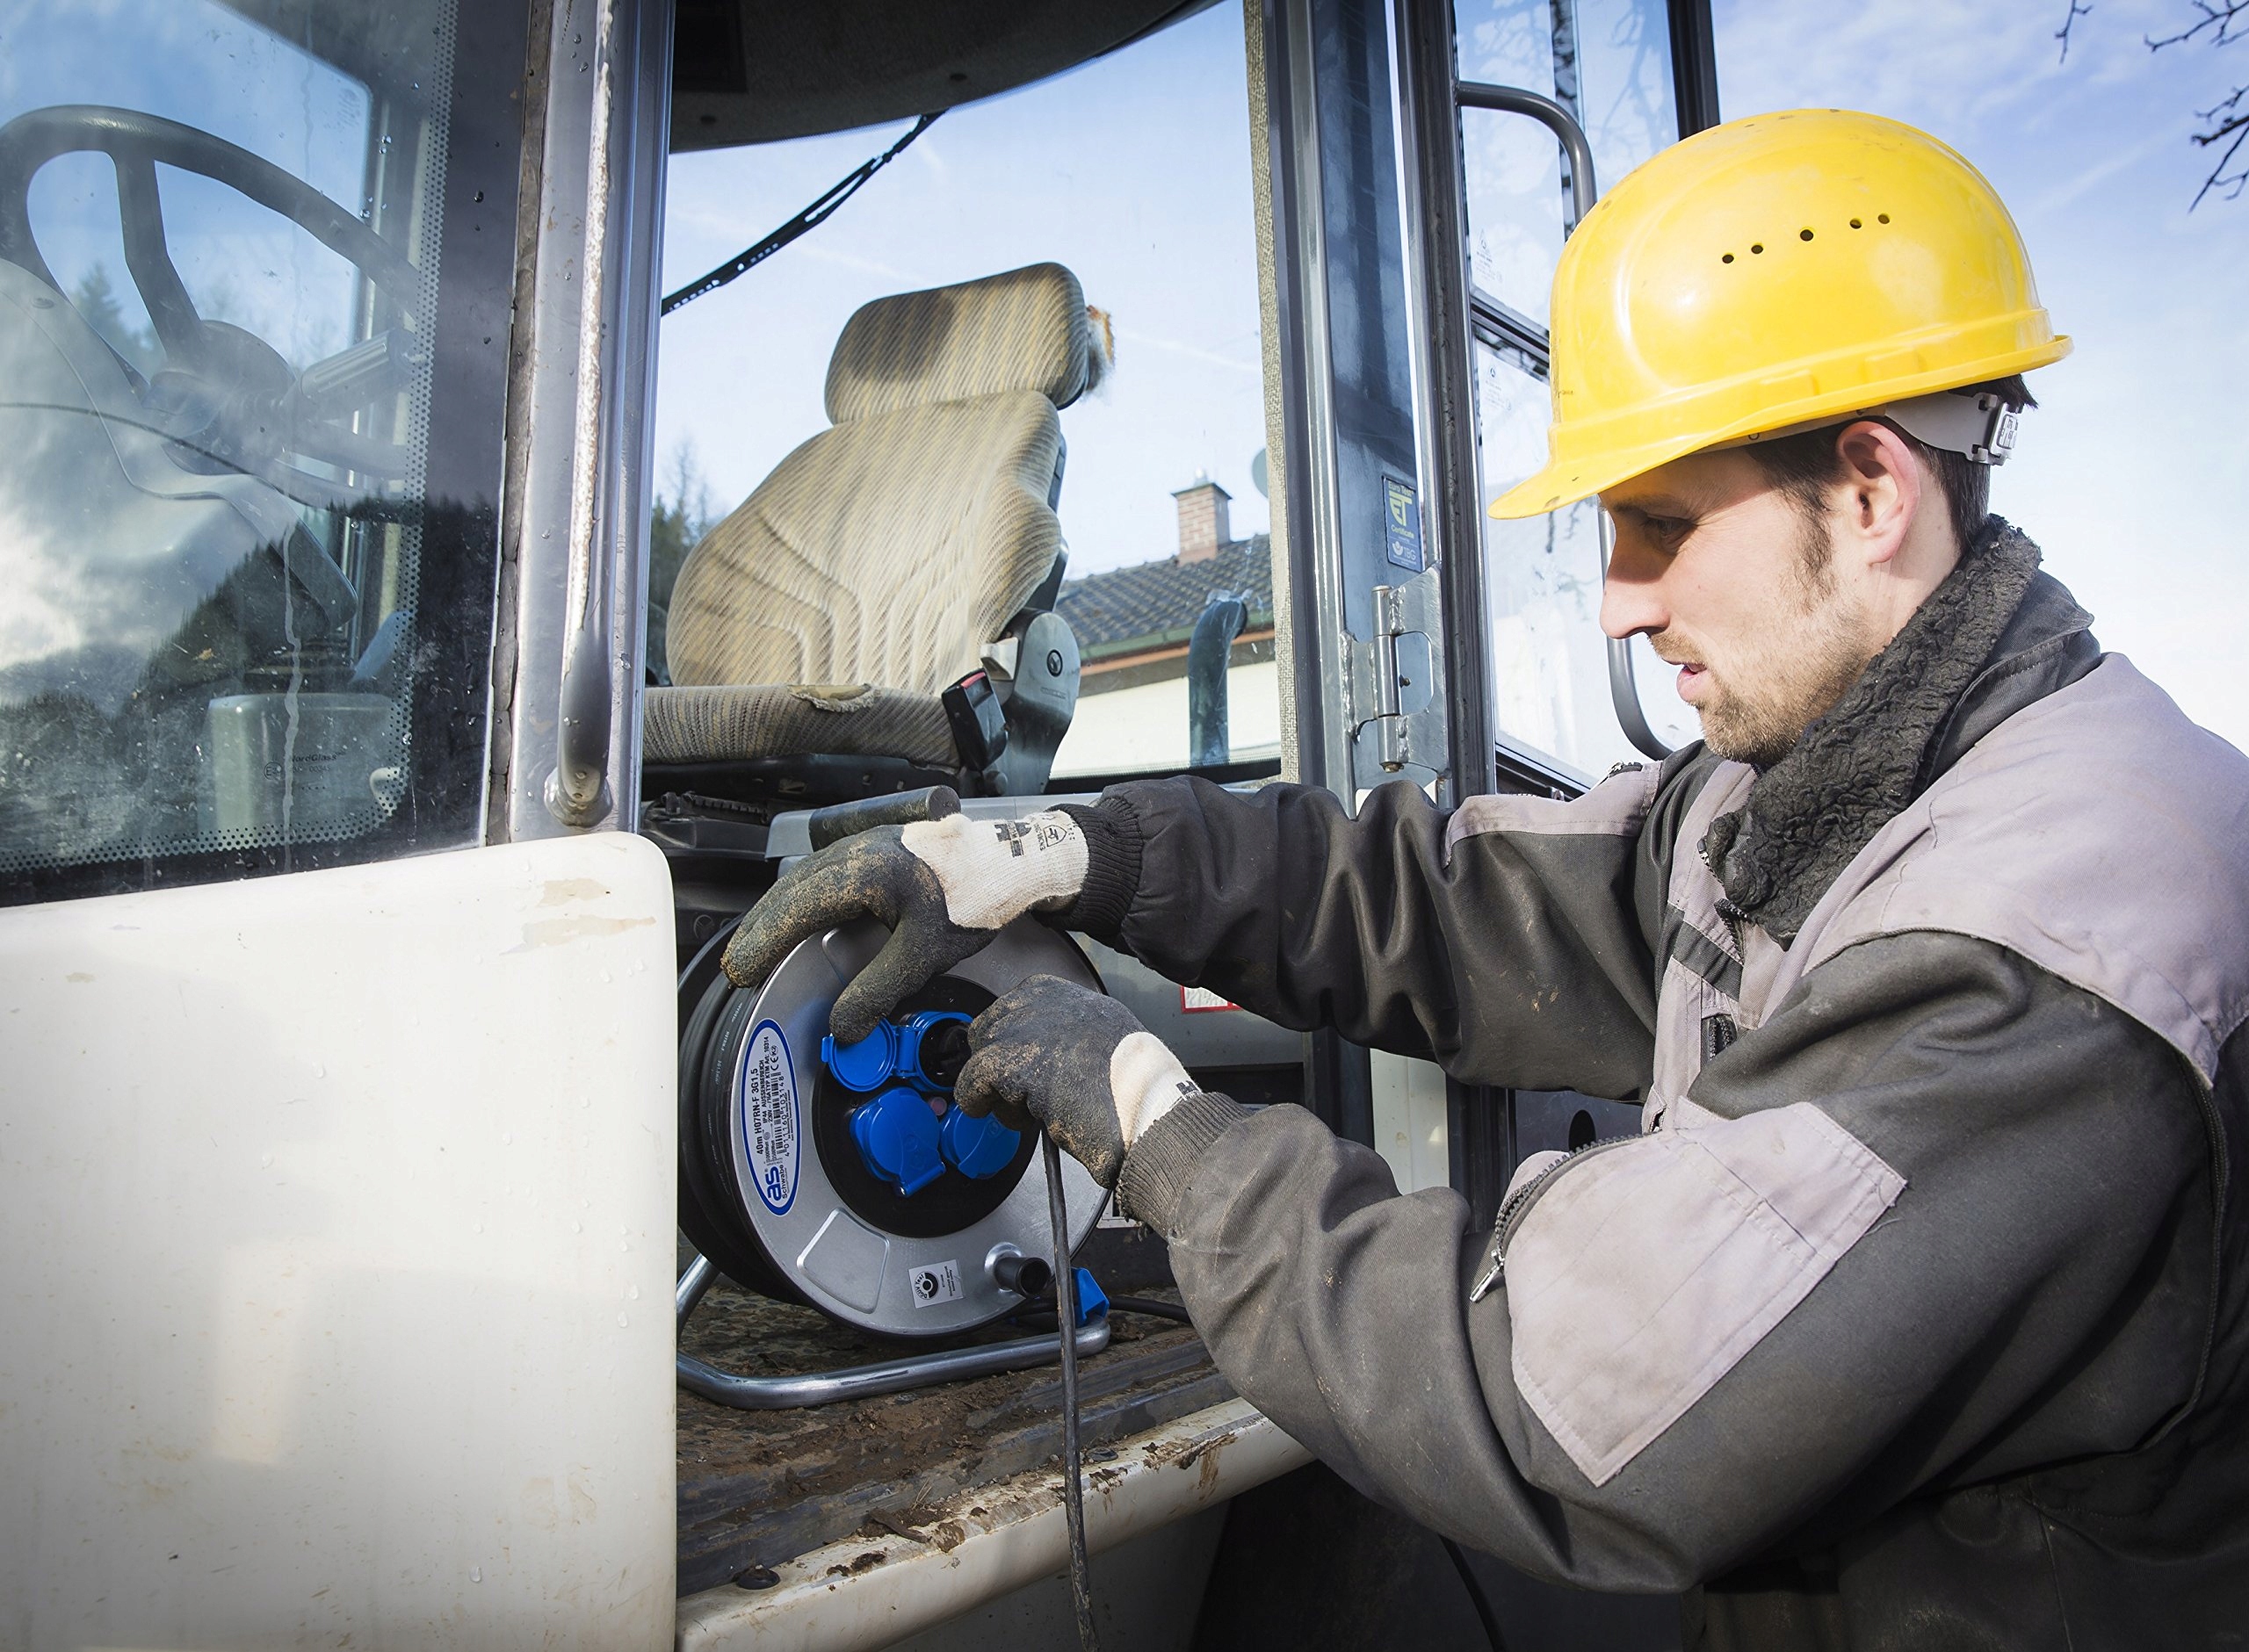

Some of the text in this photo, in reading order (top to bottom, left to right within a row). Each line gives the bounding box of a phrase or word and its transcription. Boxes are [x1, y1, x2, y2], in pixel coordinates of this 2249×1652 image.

[1391, 524, 1414, 539] Certificate
[750, 1068, 760, 1093] 3G1,5
[752, 1097, 763, 1134] H07RN-F
[765, 1166, 782, 1201] as
[778, 1165, 788, 1200] Schwabe
[915, 1273, 924, 1285] Test
